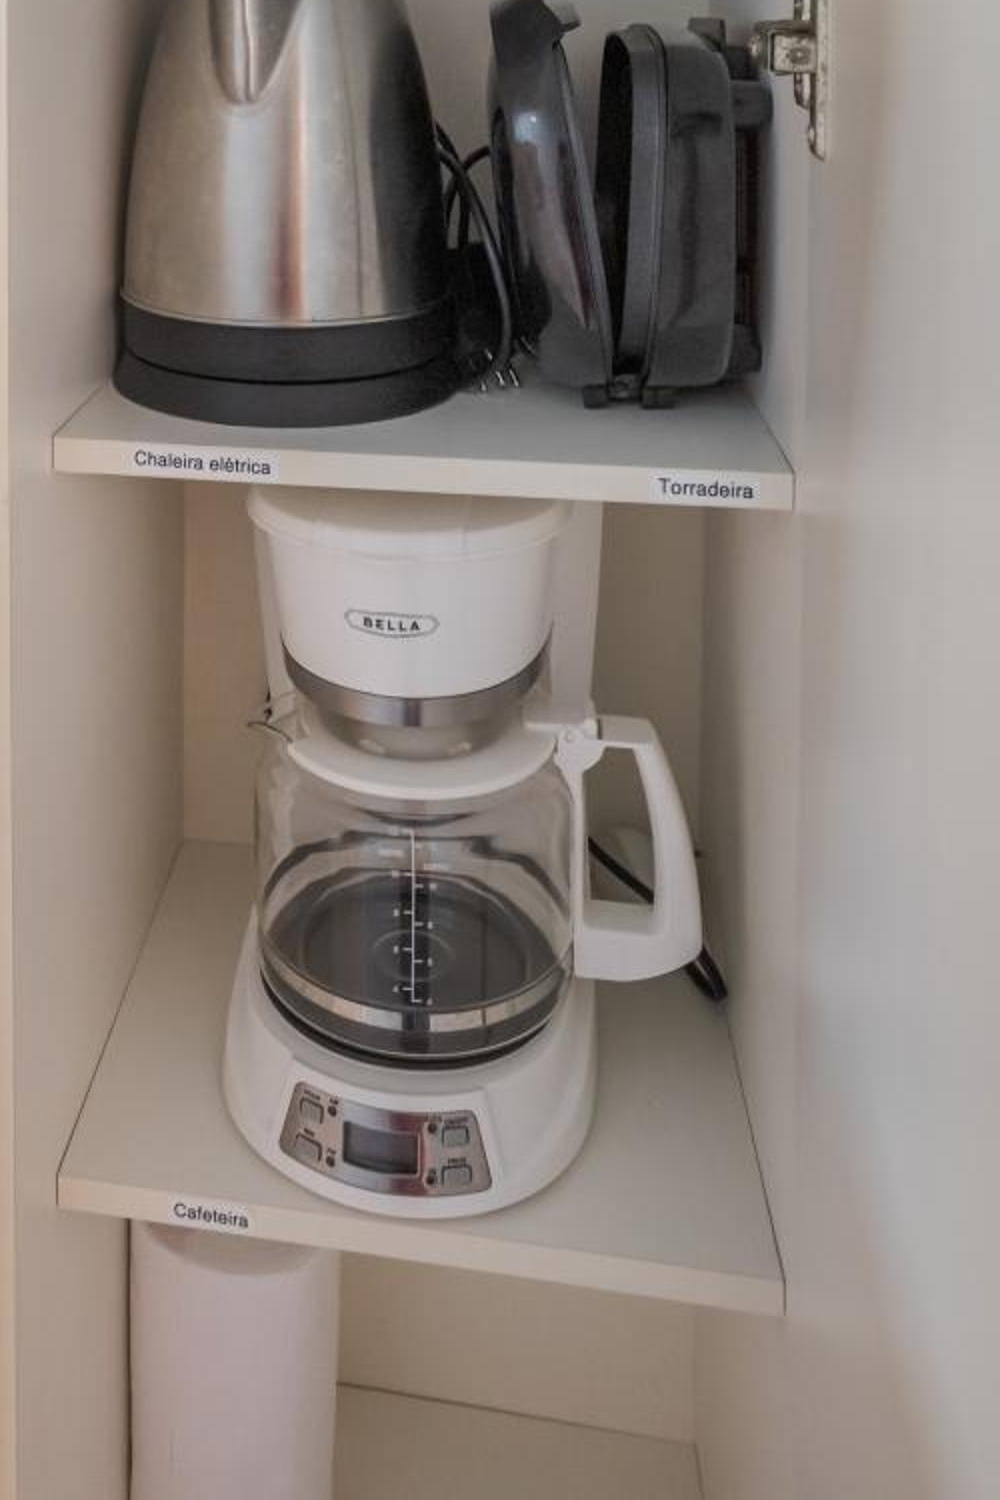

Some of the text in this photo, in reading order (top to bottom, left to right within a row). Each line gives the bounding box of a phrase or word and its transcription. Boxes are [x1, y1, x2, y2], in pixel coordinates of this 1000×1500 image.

[134, 449, 272, 475] Chaleira elétrica
[656, 477, 755, 499] Torradeira
[363, 616, 421, 632] BELLA
[173, 1203, 249, 1229] Cafeteira
